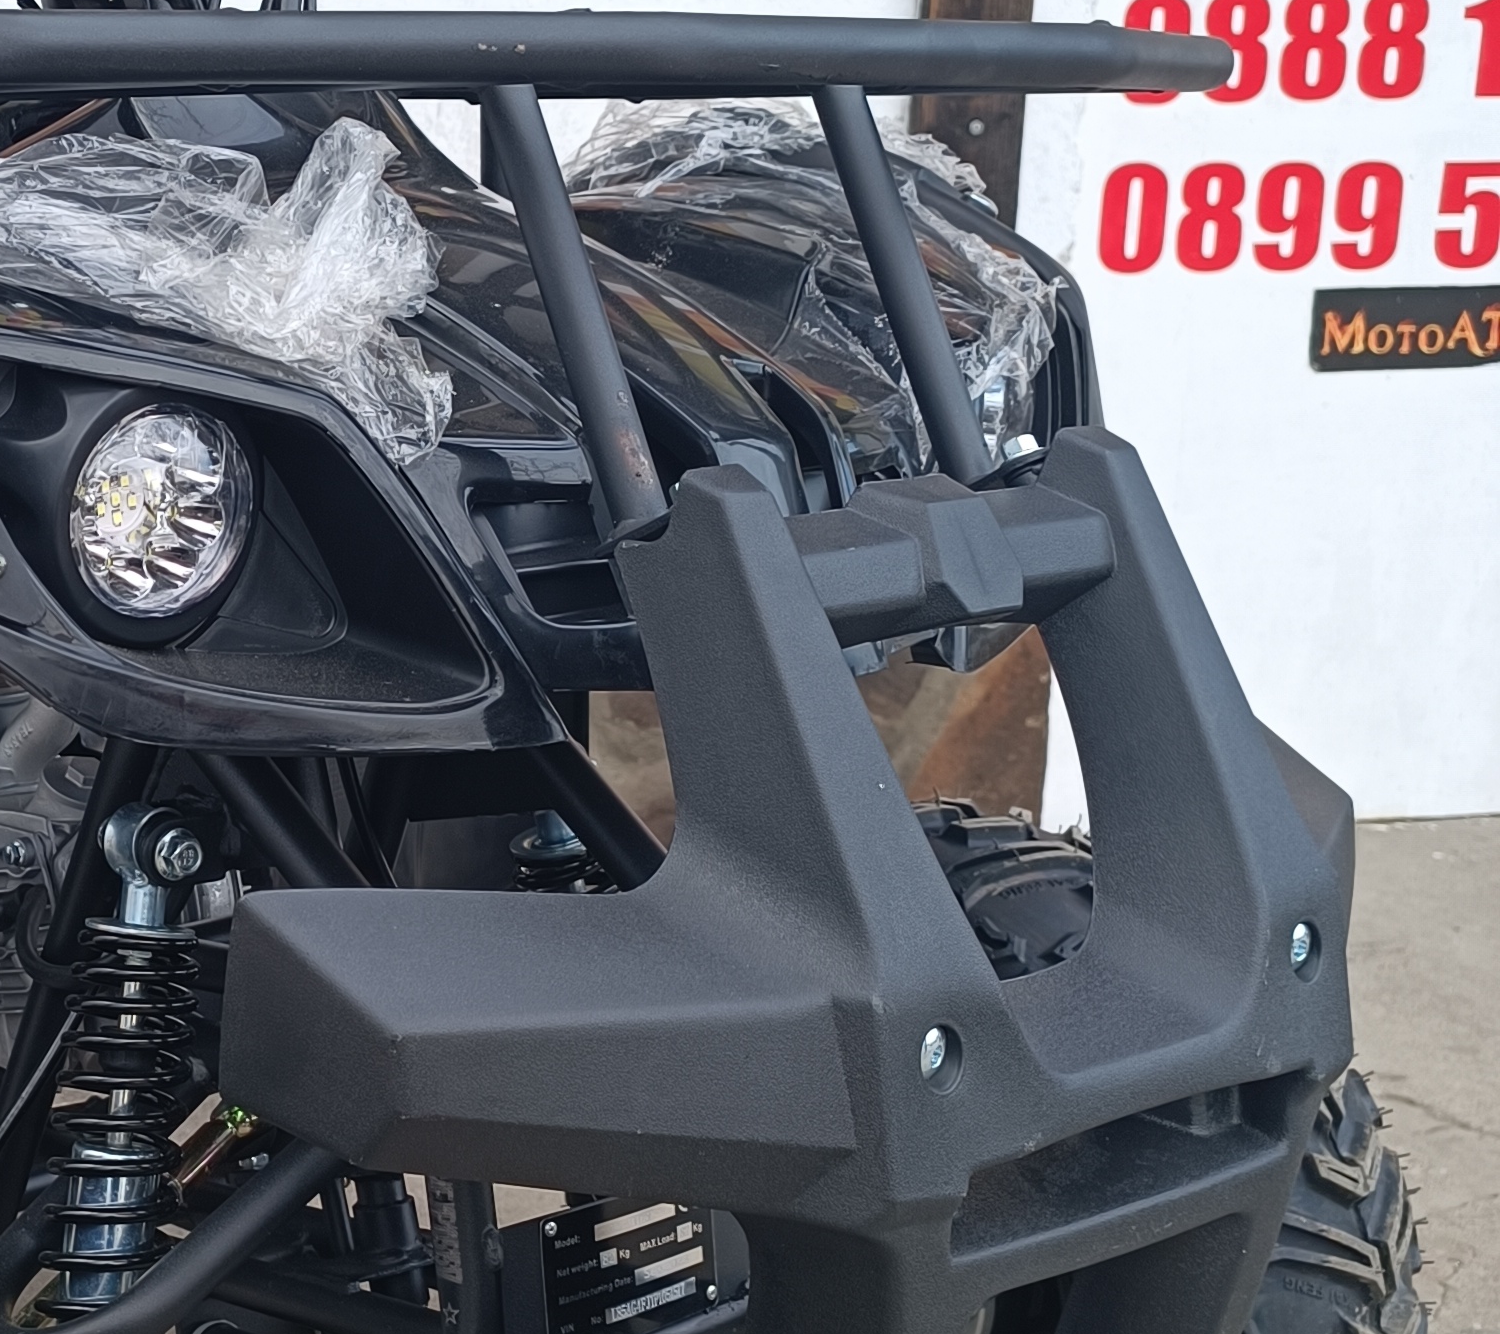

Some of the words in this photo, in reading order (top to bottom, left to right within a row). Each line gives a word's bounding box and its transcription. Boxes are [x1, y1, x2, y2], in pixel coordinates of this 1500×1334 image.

[1098, 161, 1404, 274] 0899
[1434, 161, 1500, 270] 5
[619, 1248, 630, 1259] Kg
[639, 1238, 656, 1252] MAX
[692, 1223, 703, 1233] Kg
[560, 1323, 575, 1334] VIN
